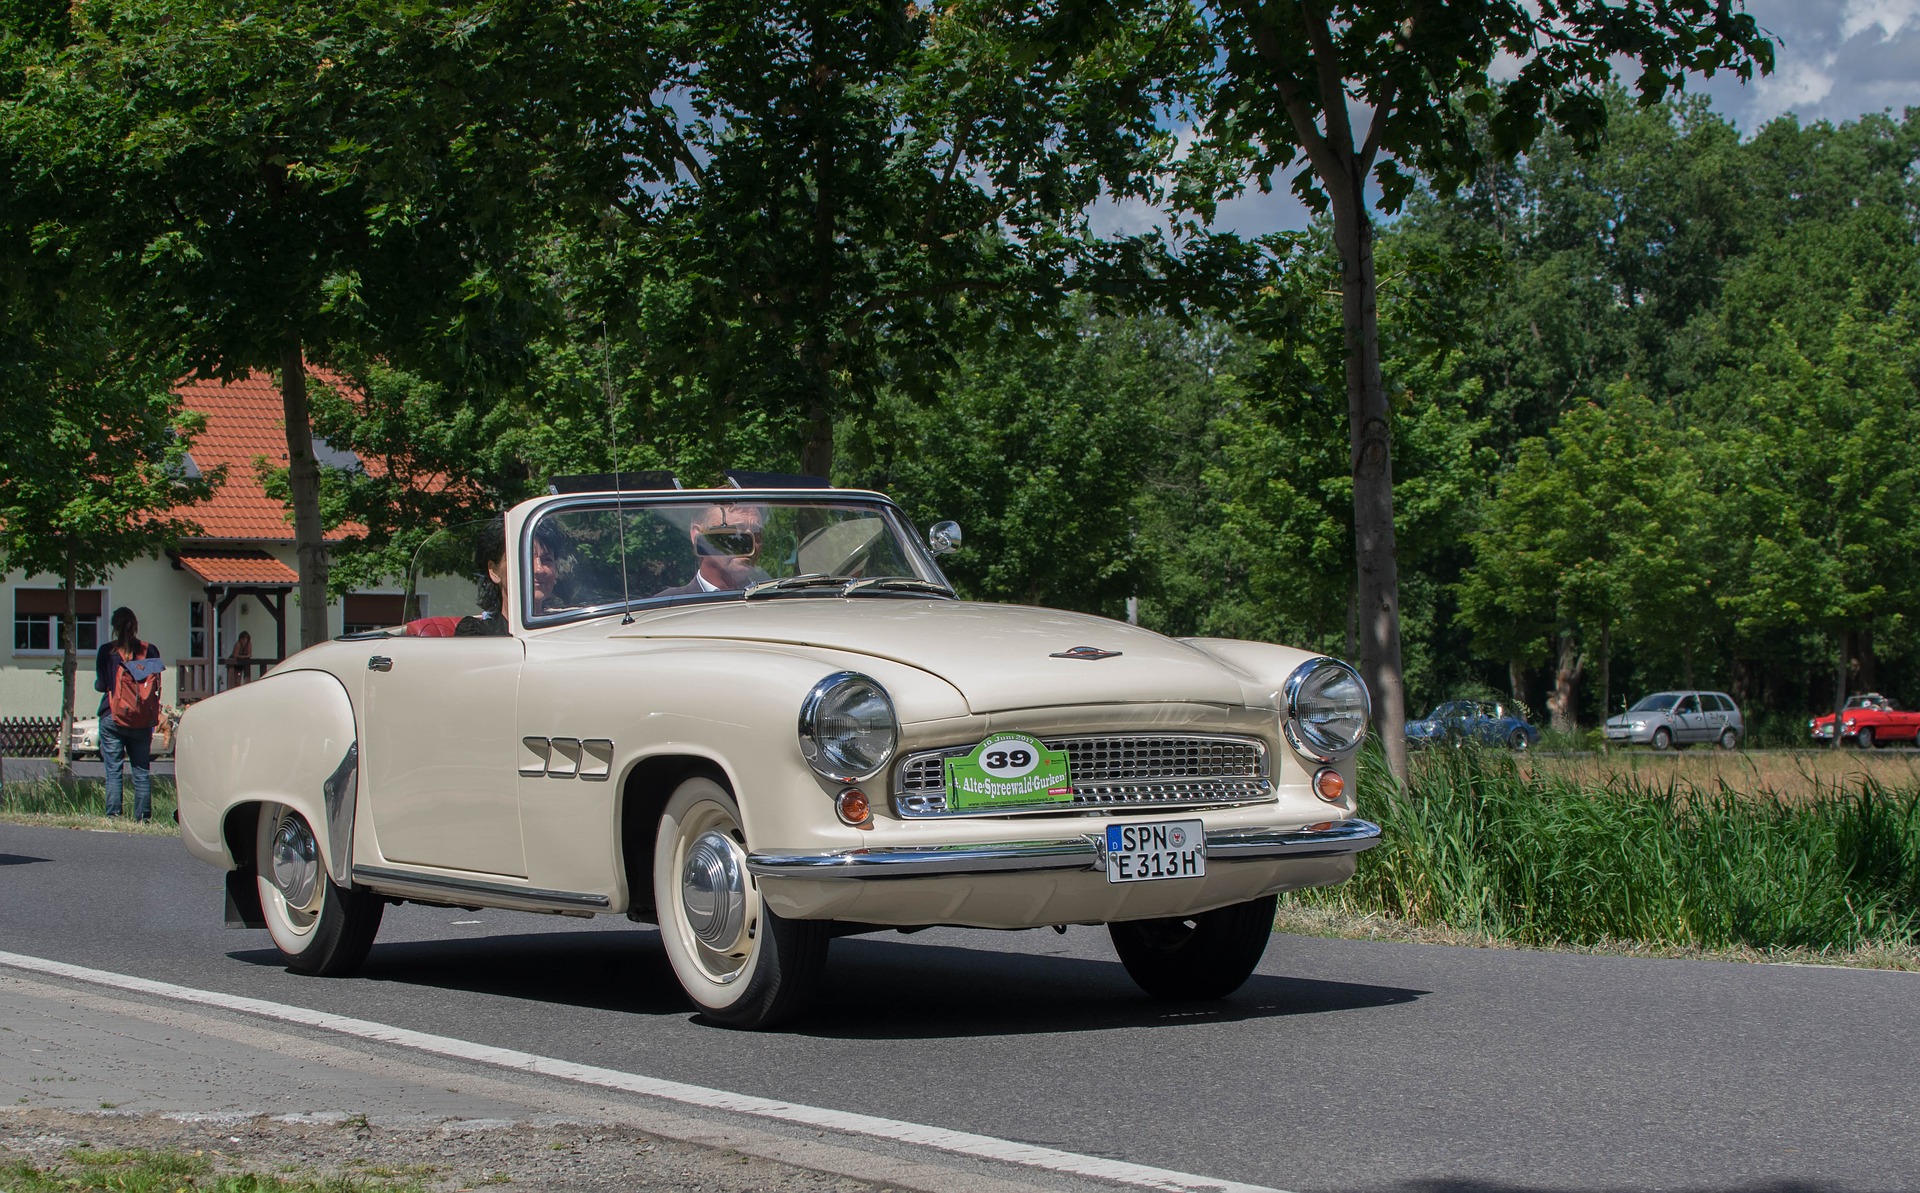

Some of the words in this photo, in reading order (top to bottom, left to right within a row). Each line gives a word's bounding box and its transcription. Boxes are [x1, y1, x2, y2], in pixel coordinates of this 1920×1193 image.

[1015, 734, 1034, 745] 2017
[986, 750, 1031, 769] 39
[1112, 841, 1119, 850] D
[1123, 825, 1167, 851] SPN
